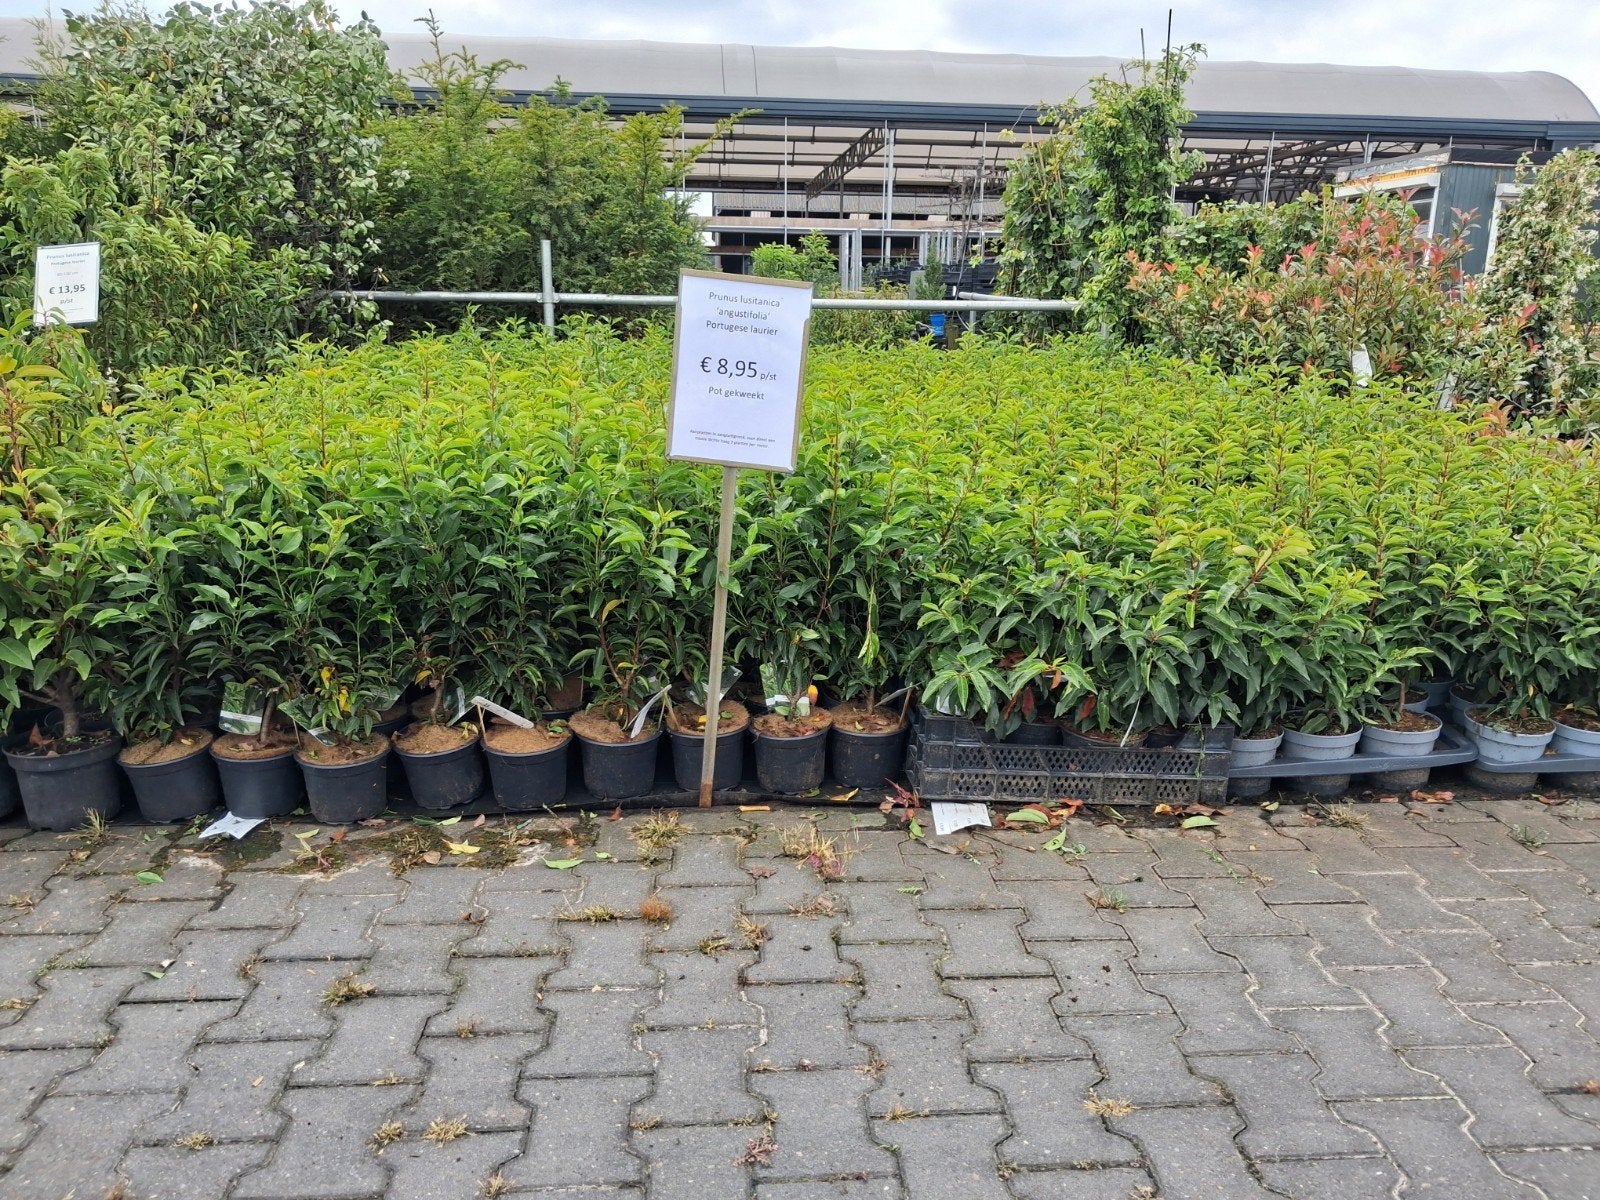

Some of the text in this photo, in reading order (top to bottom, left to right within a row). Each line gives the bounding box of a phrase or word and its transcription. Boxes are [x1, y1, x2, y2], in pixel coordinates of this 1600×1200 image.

[49, 284, 86, 295] € 13,95
[708, 291, 781, 308] Prunus lusitanica
[706, 320, 778, 336] Portugese laurier
[700, 356, 777, 382] € 8,95 p/st
[708, 386, 765, 400] Pot gekweekt
